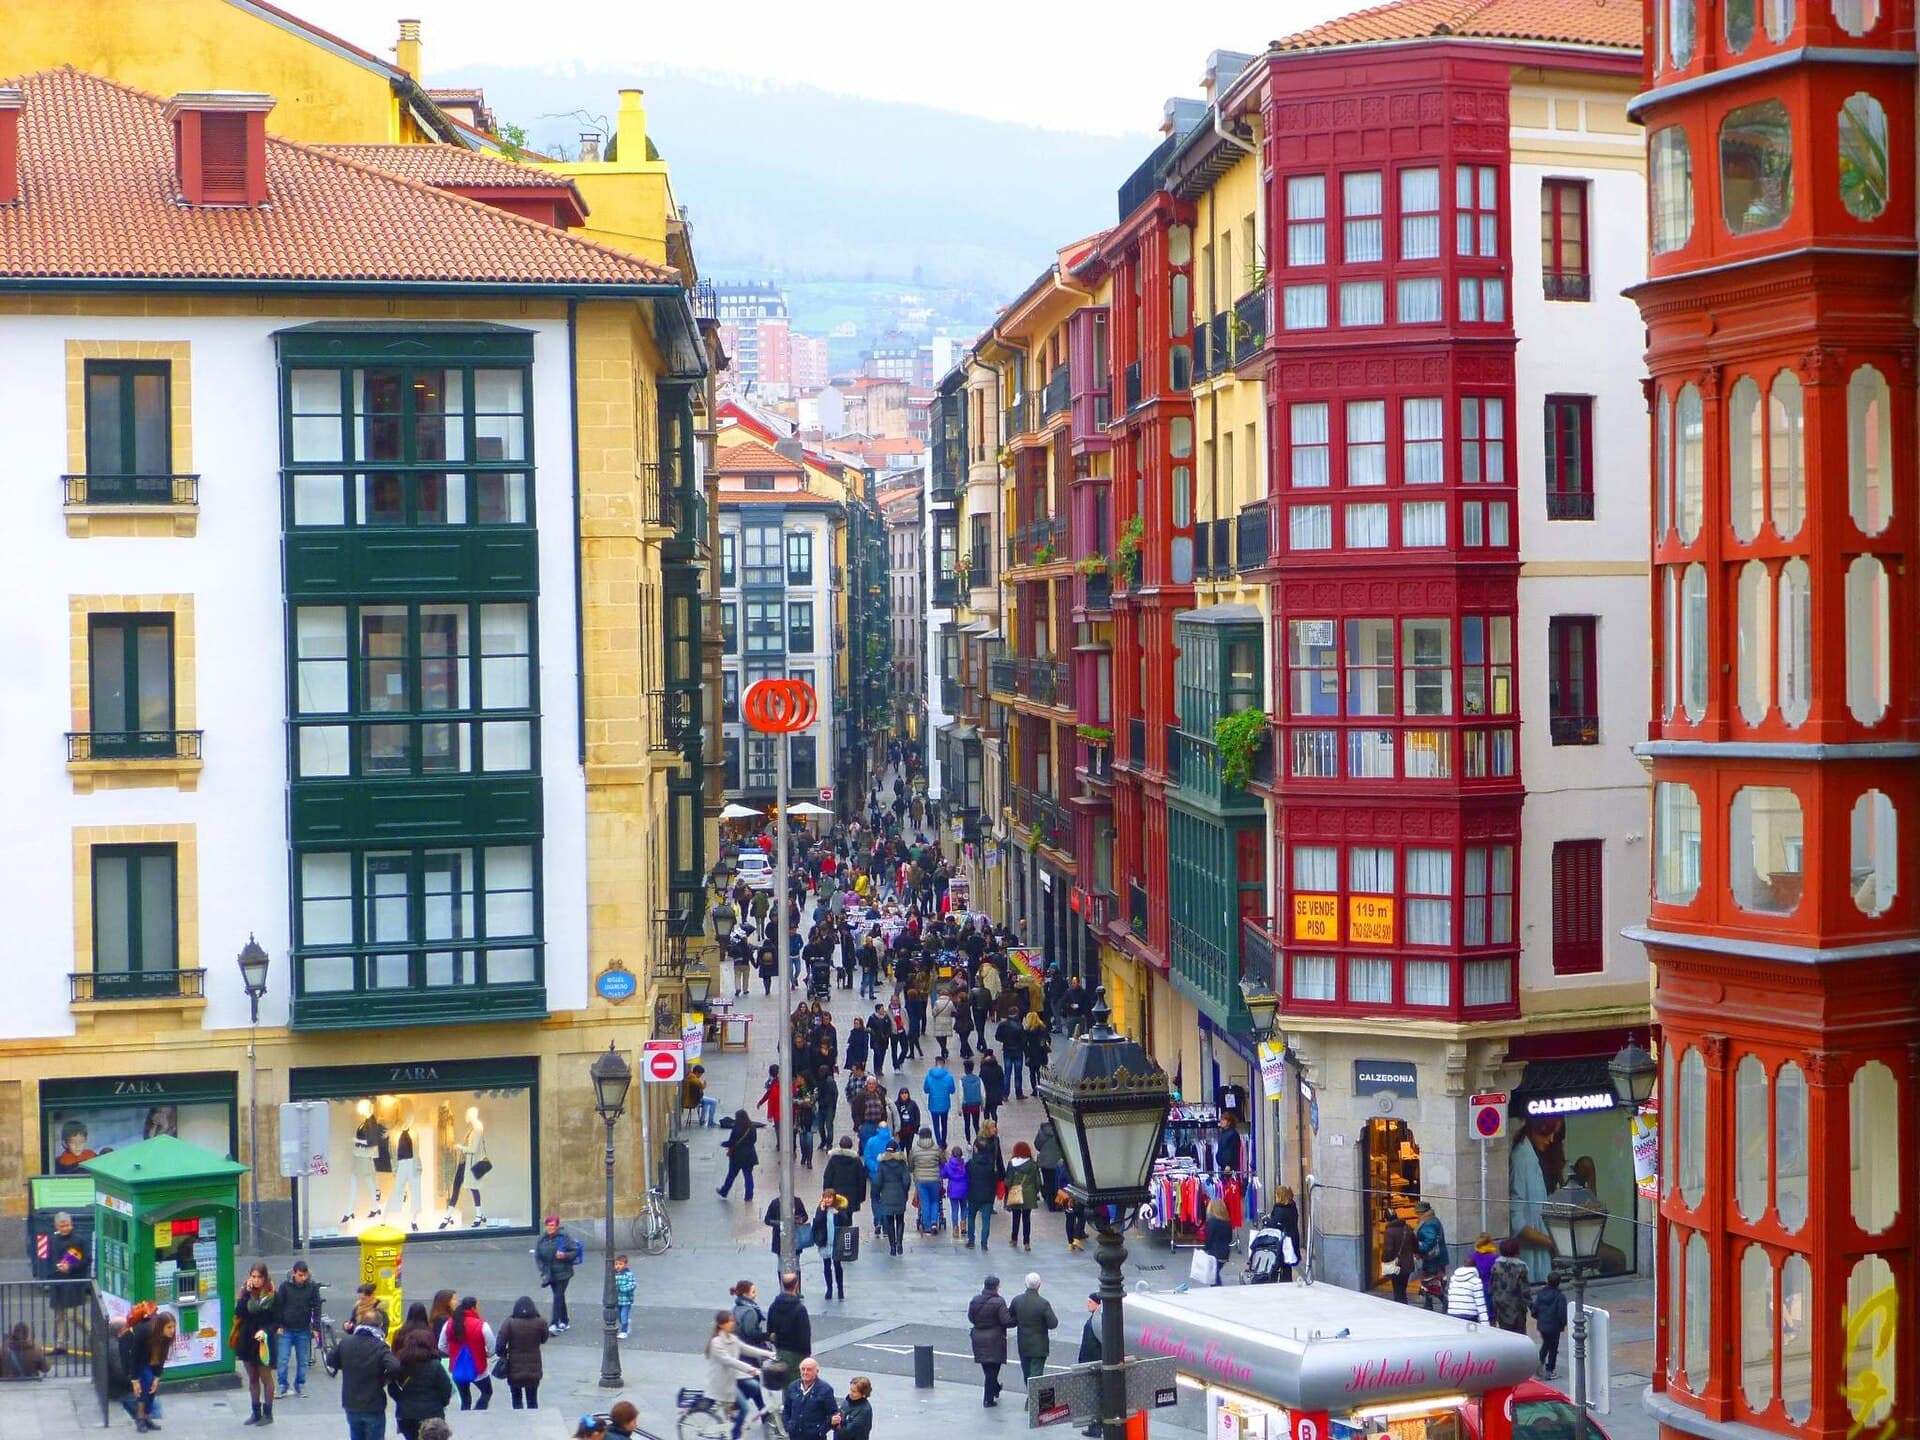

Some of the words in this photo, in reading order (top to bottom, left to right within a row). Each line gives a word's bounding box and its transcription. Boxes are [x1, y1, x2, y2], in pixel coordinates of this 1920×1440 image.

[1296, 900, 1307, 915] SE
[1308, 901, 1335, 916] VENDE
[1355, 902, 1375, 917] 119
[1307, 920, 1326, 936] PISO
[388, 1067, 439, 1081] ZARA
[1359, 1073, 1415, 1083] CALZEDONIA
[114, 1081, 165, 1095] ZARA
[1527, 1093, 1614, 1115] CALZEDONIA
[1136, 1321, 1197, 1365] Helados
[1345, 1358, 1426, 1393] Helados
